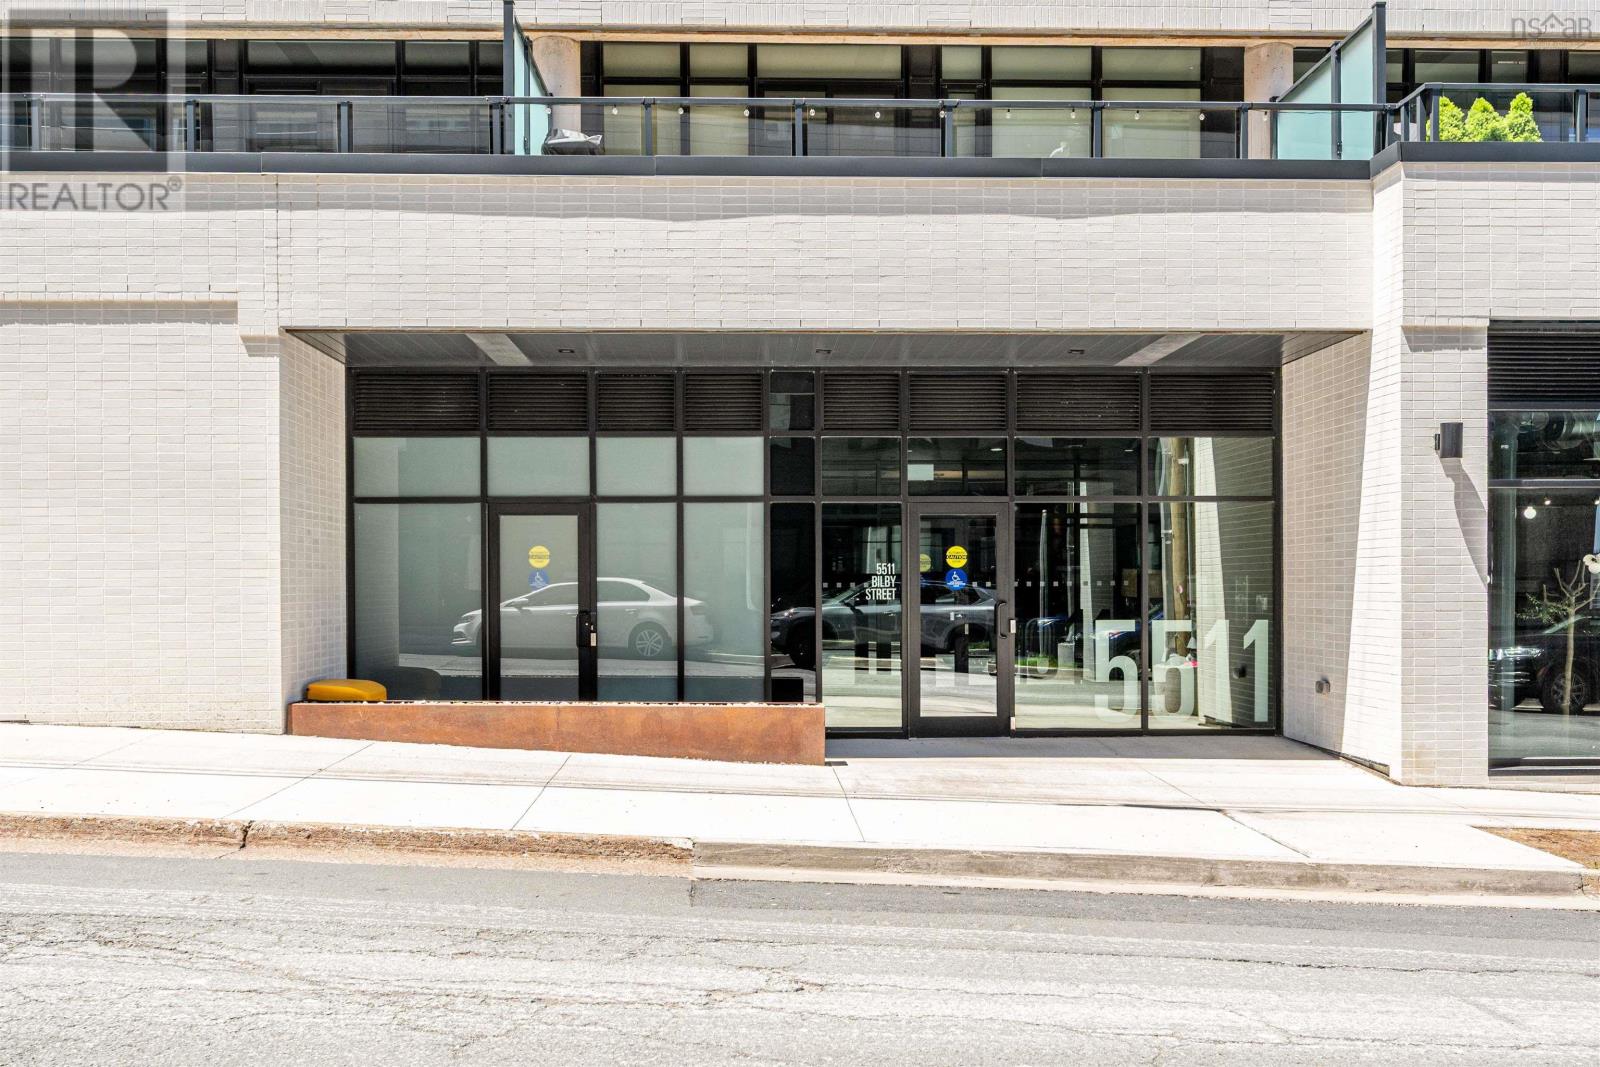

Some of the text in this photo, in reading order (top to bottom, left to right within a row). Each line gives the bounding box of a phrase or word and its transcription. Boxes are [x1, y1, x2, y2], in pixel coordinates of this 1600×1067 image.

[876, 562, 896, 575] 5511
[871, 575, 897, 588] BILBY
[865, 588, 897, 600] STREET
[1094, 619, 1269, 723] 5511
